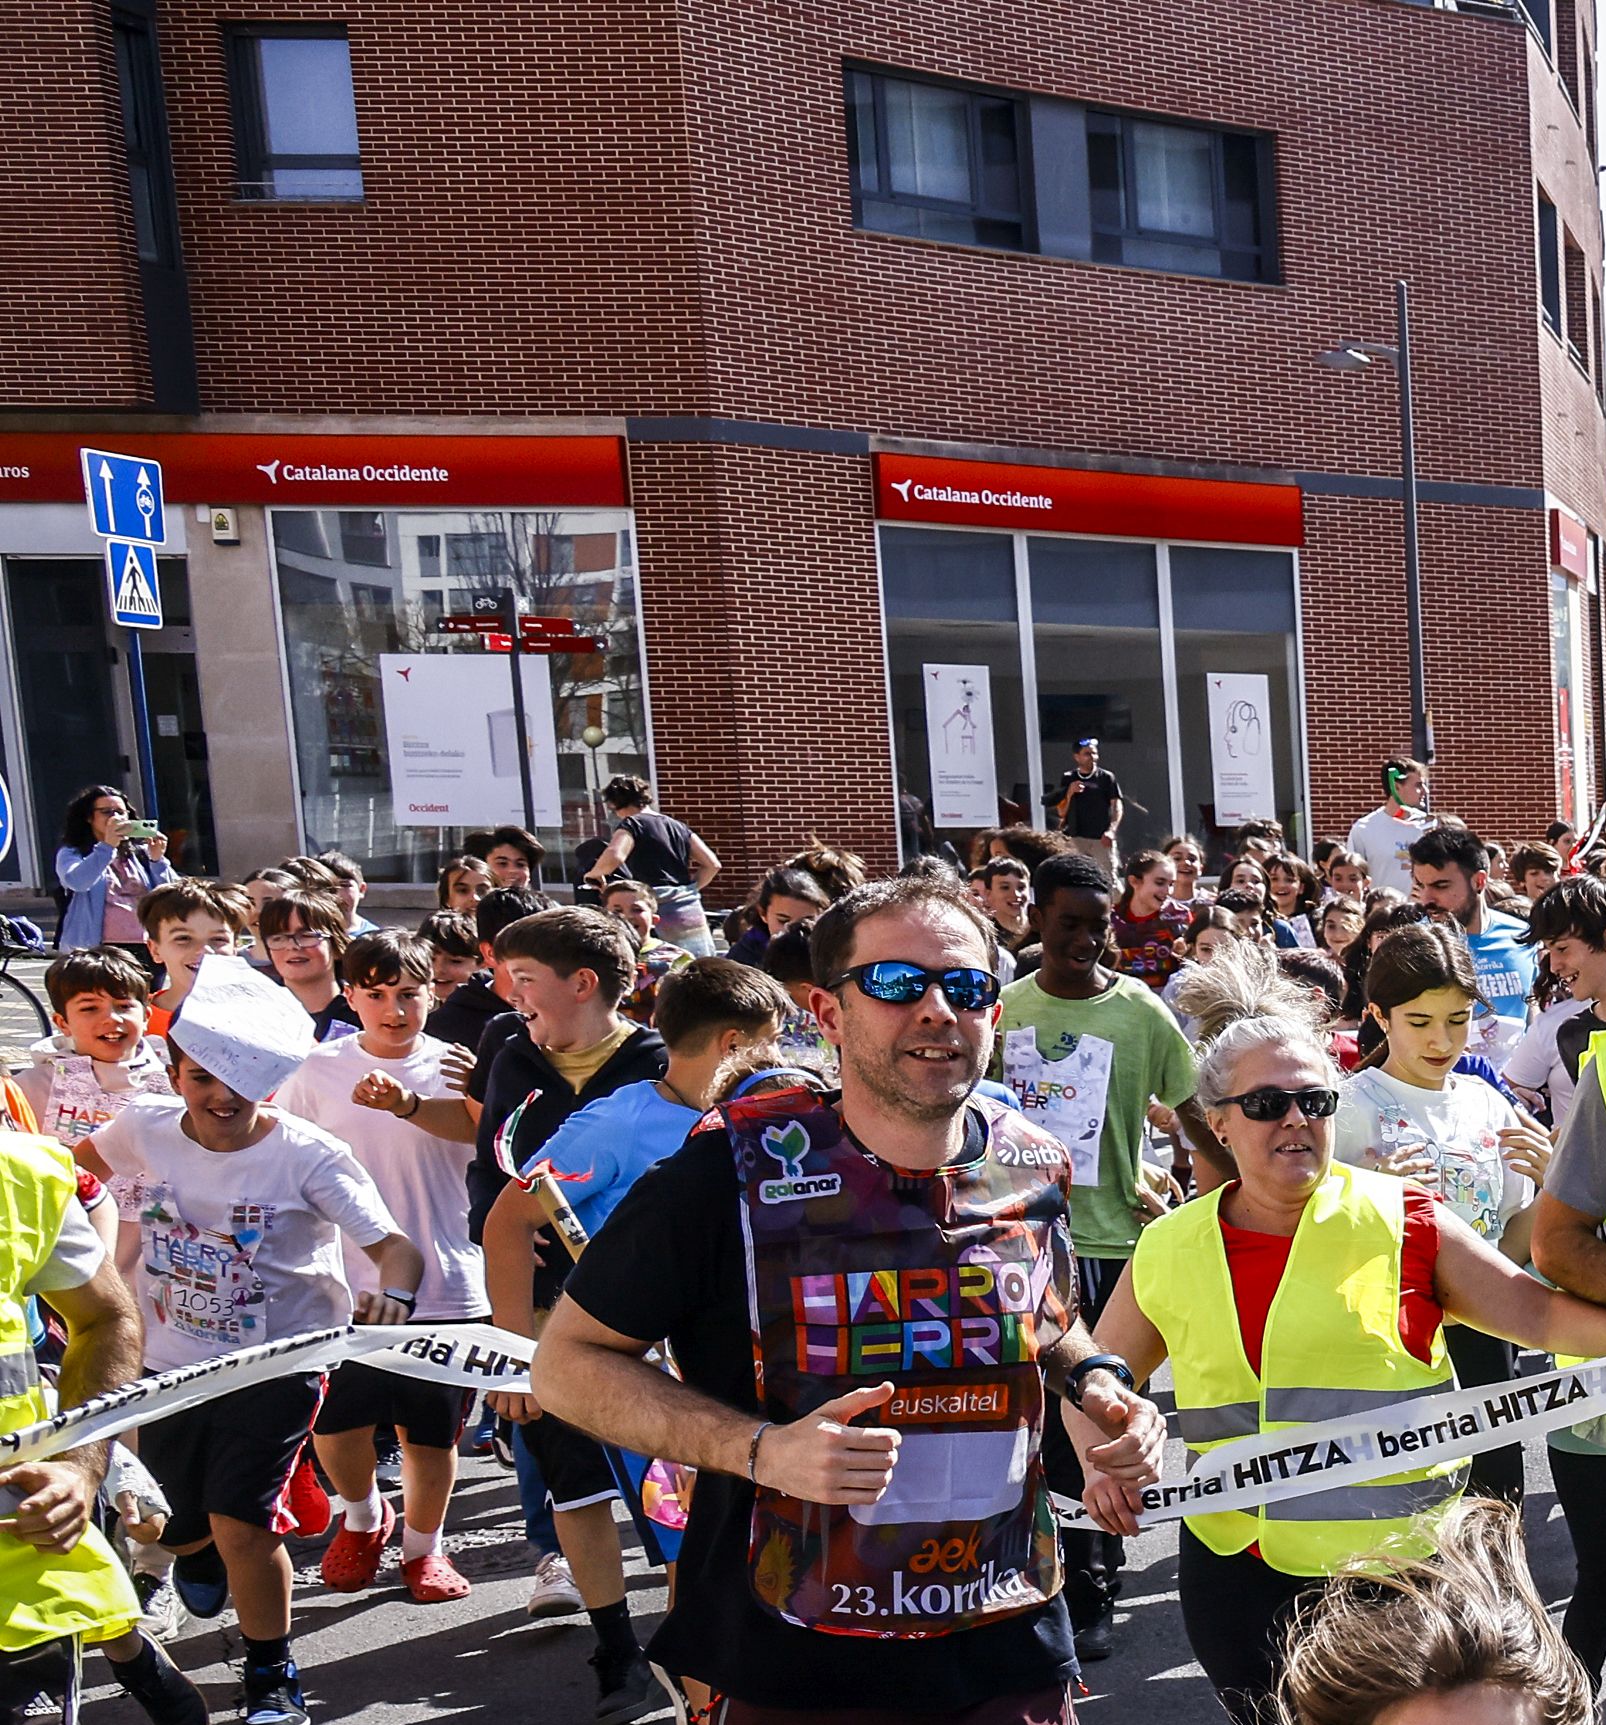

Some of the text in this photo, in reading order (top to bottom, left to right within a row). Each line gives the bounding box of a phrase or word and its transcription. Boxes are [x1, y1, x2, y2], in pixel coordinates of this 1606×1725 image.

[282, 464, 449, 483] Catalana Occidente
[913, 484, 1053, 510] Catalana Occidente
[409, 803, 449, 813] Occident
[1012, 1079, 1077, 1100] HARRO
[1022, 1143, 1062, 1166] eitb
[174, 1288, 234, 1317] 1053
[790, 1261, 1034, 1326] HARRO
[796, 1312, 1039, 1376] HERRI
[890, 1391, 998, 1416] euskaltel
[1142, 1473, 1222, 1511] erria
[1233, 1439, 1352, 1490] HITZA
[1376, 1410, 1477, 1459] berria
[1484, 1376, 1588, 1429] HITZA
[909, 1523, 982, 1573] aek
